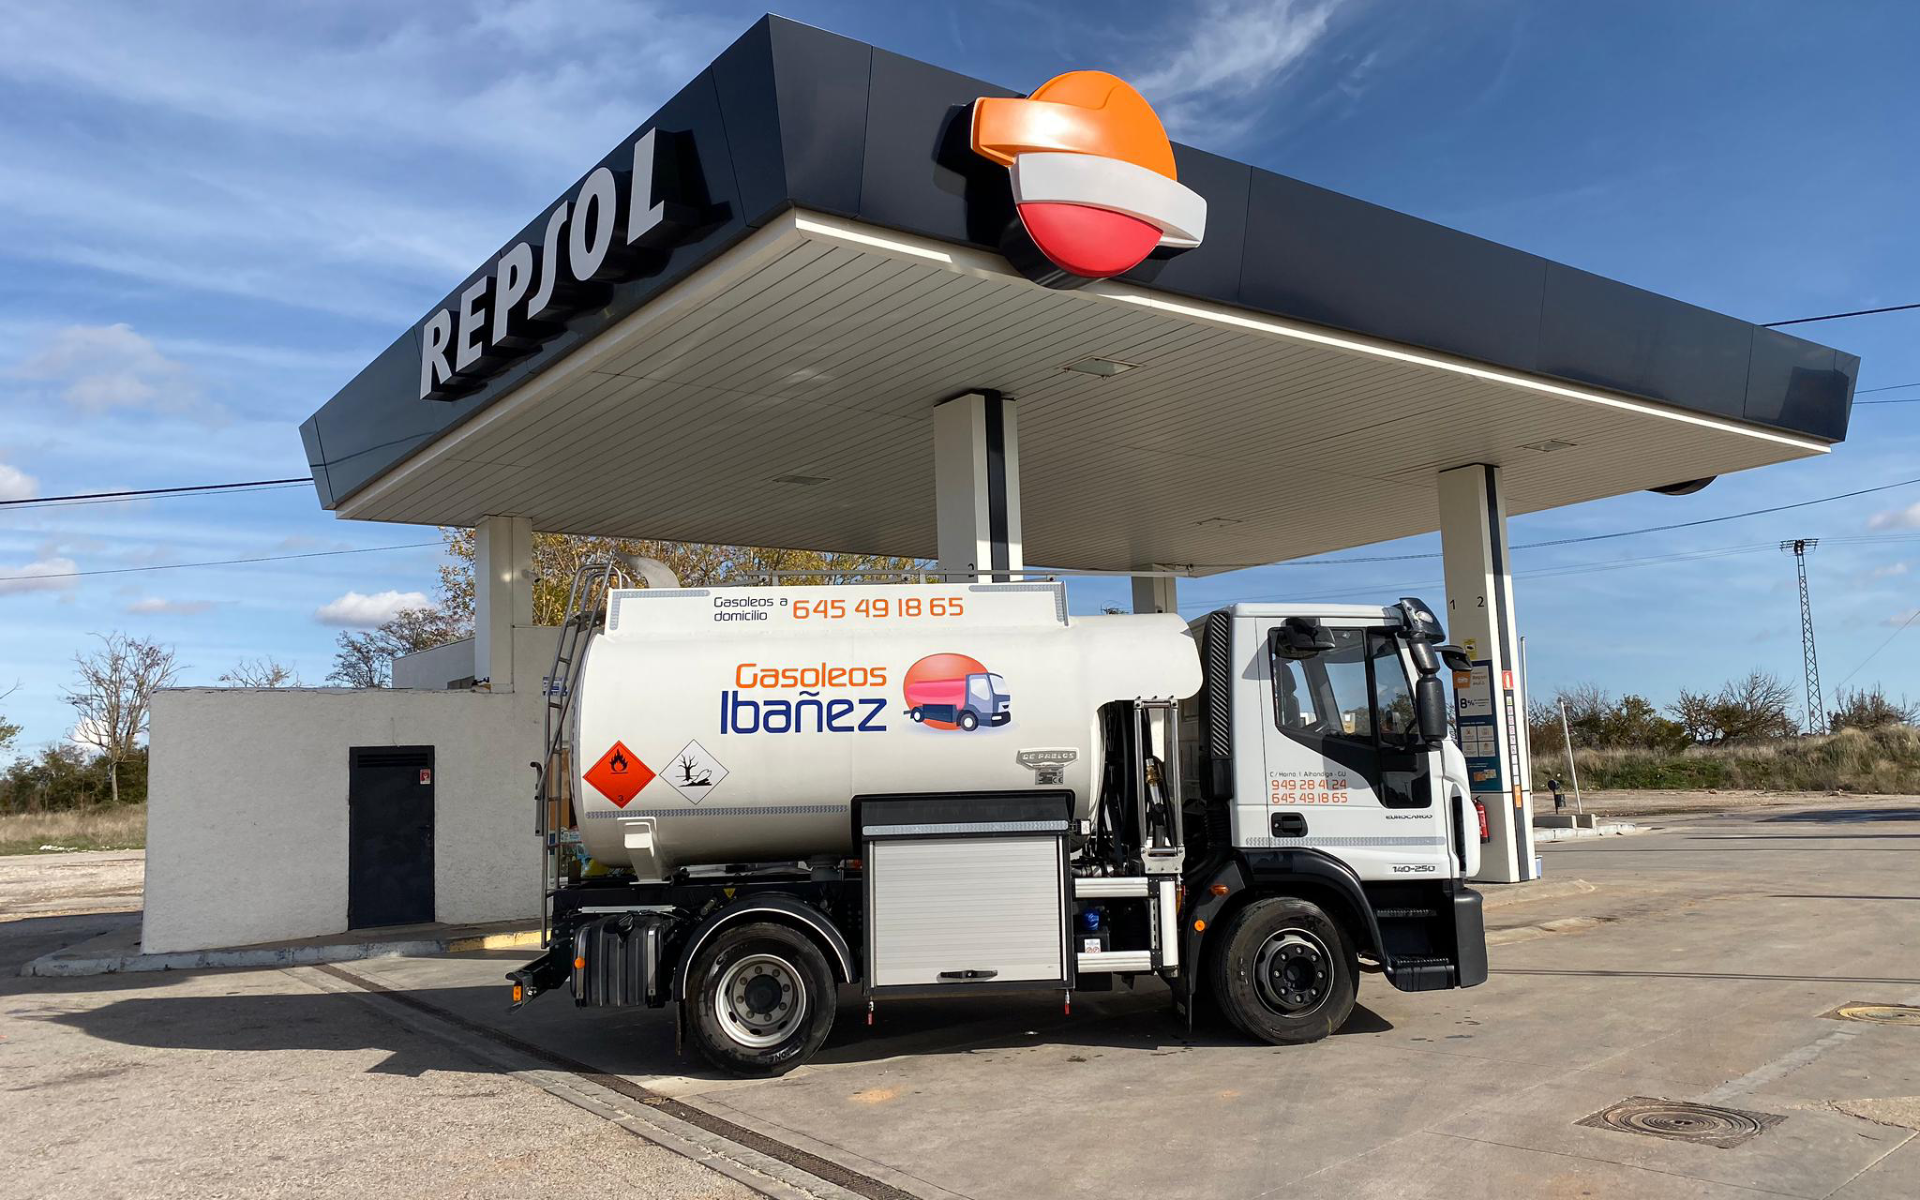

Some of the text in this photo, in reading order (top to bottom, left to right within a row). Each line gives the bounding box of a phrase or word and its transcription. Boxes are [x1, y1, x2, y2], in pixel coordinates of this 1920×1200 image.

[420, 127, 664, 400] REPSOL
[714, 597, 788, 608] Gasoleos a
[793, 597, 964, 619] 645 49 18 65
[1449, 596, 1485, 610] 1 2
[714, 610, 768, 622] domicilio
[736, 662, 887, 688] Gasoleos
[720, 690, 887, 734] Ibañez
[1271, 779, 1347, 790] 949 28 41 24
[618, 794, 624, 802] 3
[1272, 793, 1348, 804] 645 49 18 65
